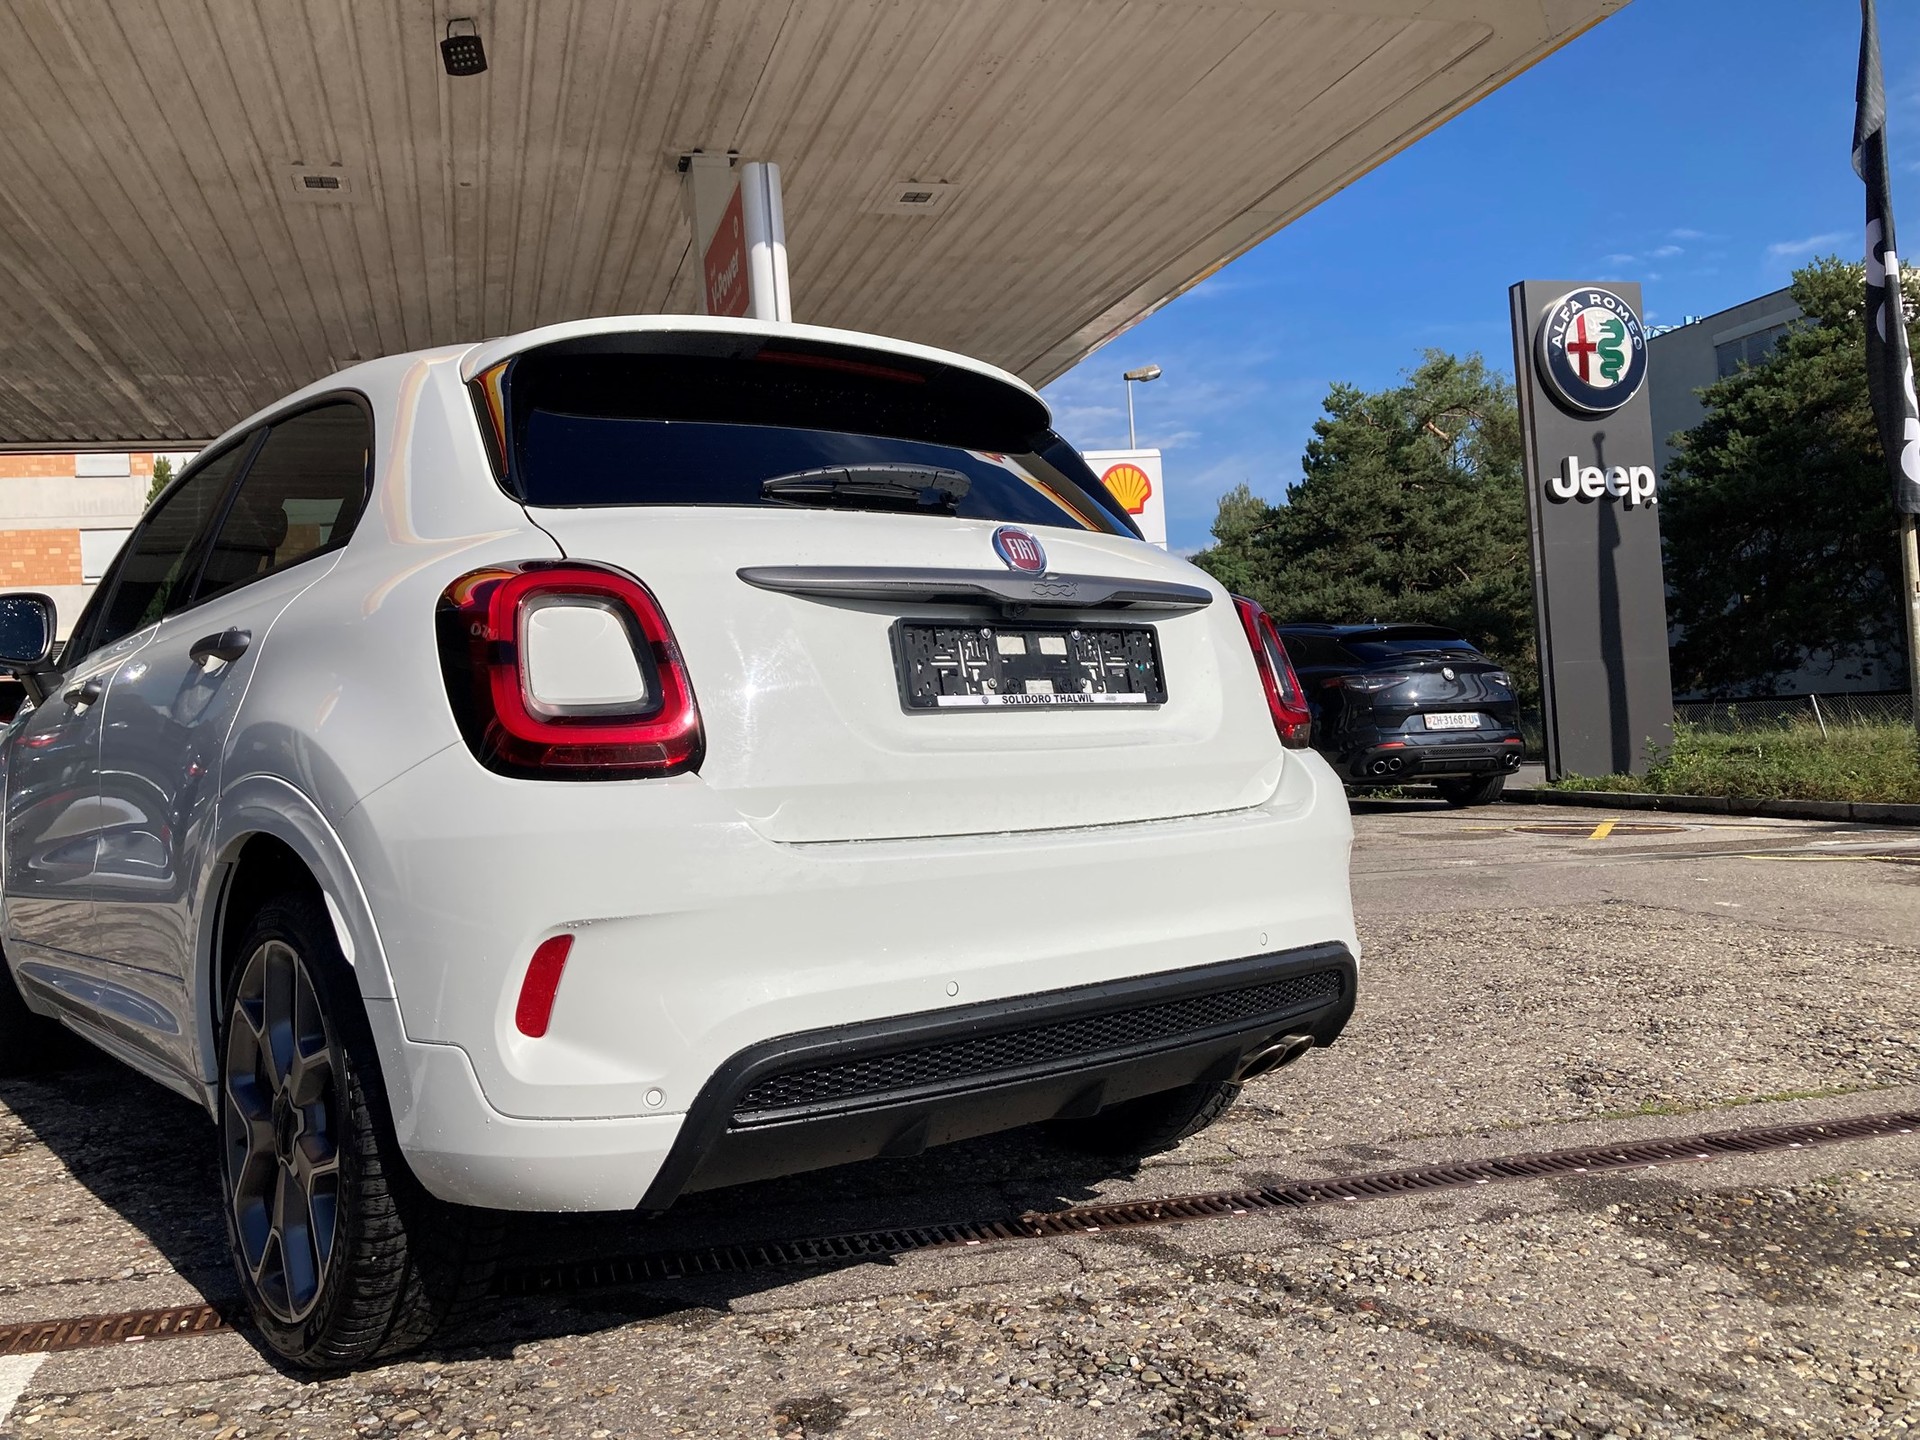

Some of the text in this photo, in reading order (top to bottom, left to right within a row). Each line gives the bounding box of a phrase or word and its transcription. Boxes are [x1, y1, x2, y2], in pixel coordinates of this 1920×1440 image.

[1551, 293, 1643, 351] ALFA ROMEO
[1551, 456, 1656, 505] Jeep
[1005, 538, 1037, 561] FIAT
[1002, 693, 1094, 704] SOLIDORO THALWIL
